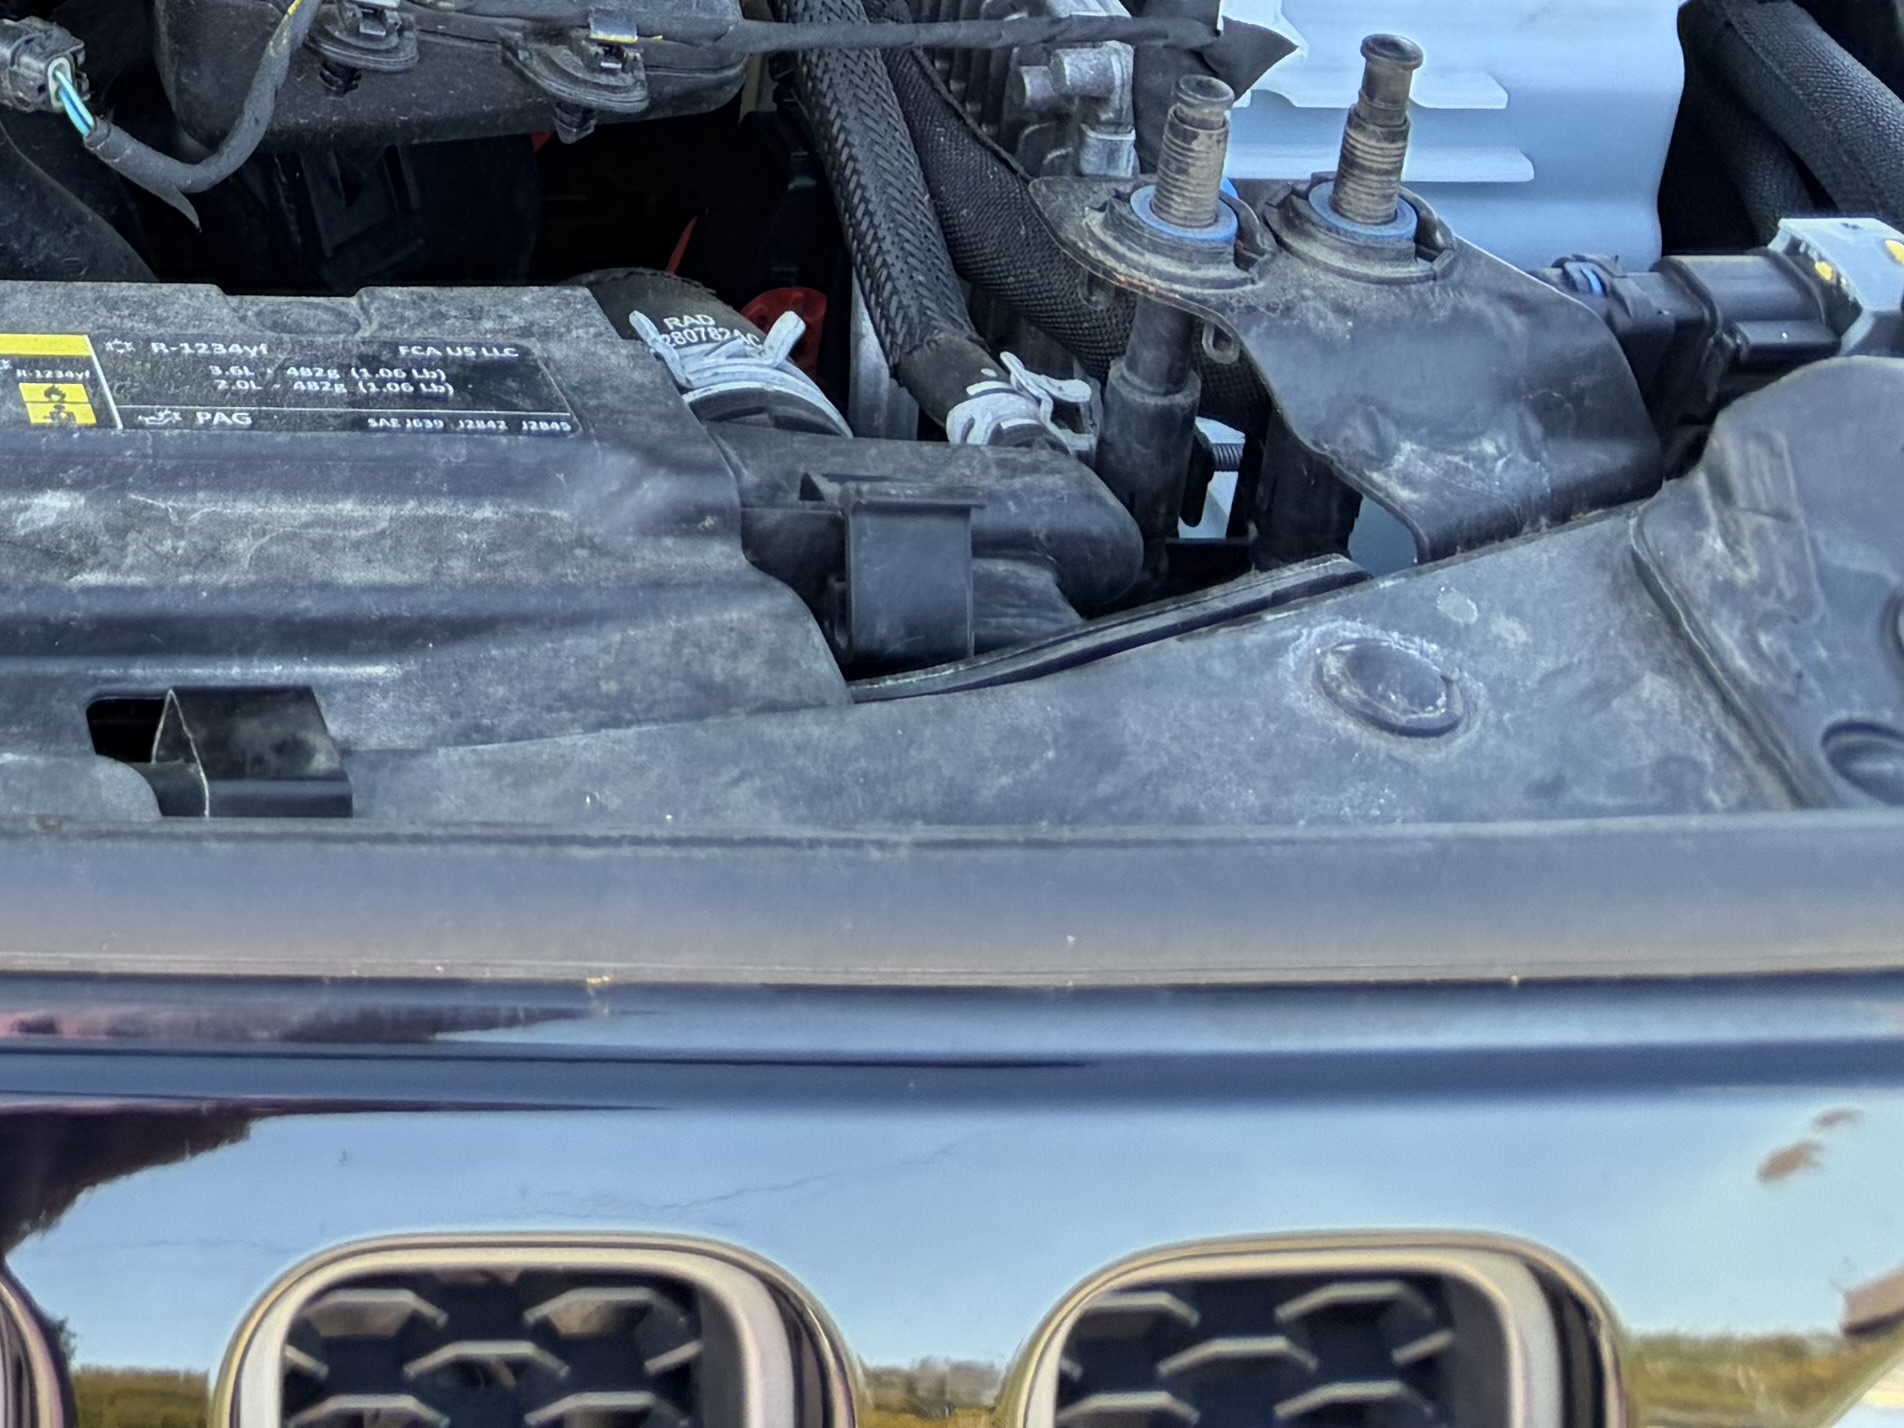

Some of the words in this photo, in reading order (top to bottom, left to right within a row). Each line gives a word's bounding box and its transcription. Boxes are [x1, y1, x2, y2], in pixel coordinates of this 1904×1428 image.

[663, 313, 716, 331] RAD
[150, 342, 269, 358] R-1234yf
[398, 345, 442, 357] FCA
[446, 346, 476, 358] US
[481, 346, 519, 358] LLC
[15, 368, 91, 380] R-1234yf
[209, 365, 255, 377] 3.6L
[286, 366, 341, 380] 482g
[351, 367, 407, 380] (1.06
[213, 379, 264, 391] 2.0L
[293, 380, 348, 394] 482g
[358, 381, 414, 394] (1.06
[195, 411, 253, 426] PAG
[368, 417, 401, 428] SAE
